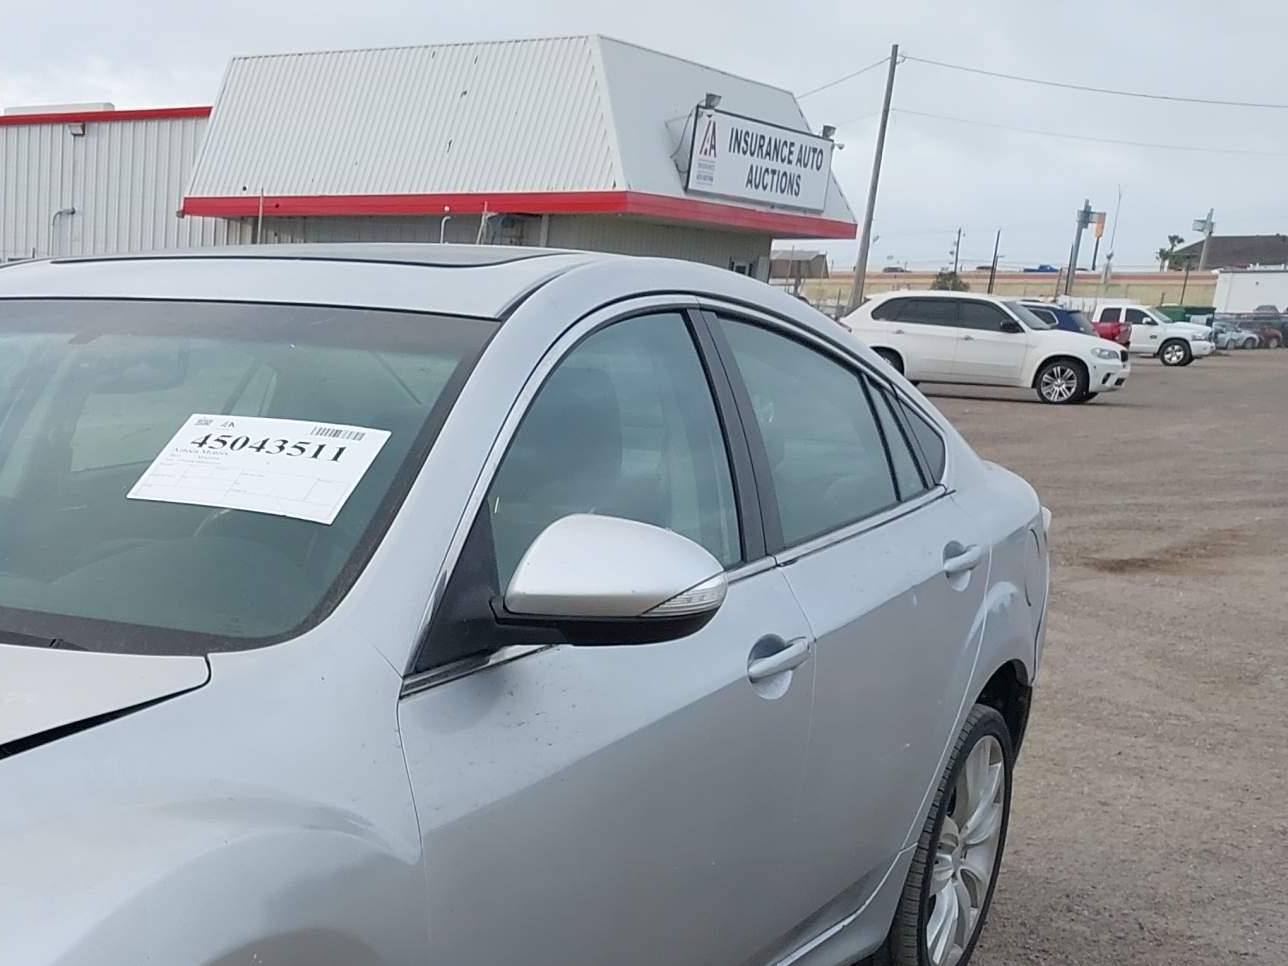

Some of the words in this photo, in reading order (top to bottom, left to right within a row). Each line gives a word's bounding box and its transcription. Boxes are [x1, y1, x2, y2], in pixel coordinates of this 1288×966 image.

[728, 127, 795, 165] INSURANCE
[795, 144, 824, 172] AUTO
[745, 164, 801, 197] AUCTIONS
[190, 433, 347, 463] 45043511
